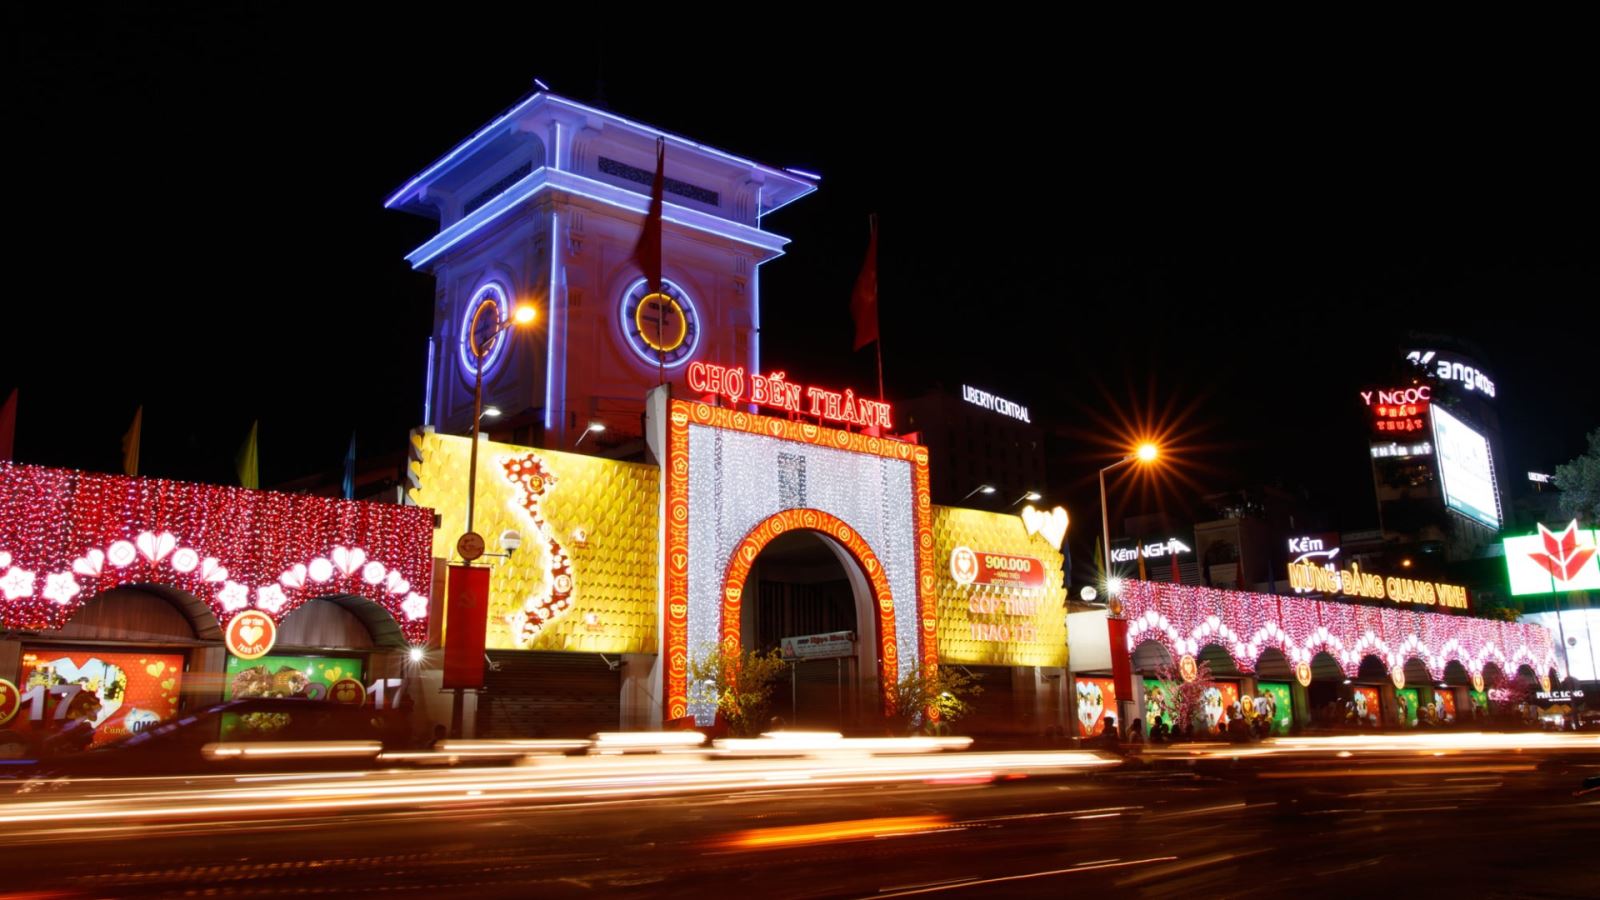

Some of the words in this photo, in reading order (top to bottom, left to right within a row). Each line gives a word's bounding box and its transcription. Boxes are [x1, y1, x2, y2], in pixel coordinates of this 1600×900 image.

[688, 361, 744, 402] CHỢ
[751, 371, 801, 411] BẾN
[807, 387, 892, 428] THÀNH
[962, 384, 995, 411] LIBERTY
[994, 396, 1031, 424] CENTRAL
[1378, 386, 1431, 405] NGỌC
[984, 554, 1032, 573] 900.000
[1287, 557, 1340, 594] MỪNG
[1386, 576, 1437, 606] QUANG
[1434, 582, 1469, 610] VINH
[20, 685, 82, 720] 17
